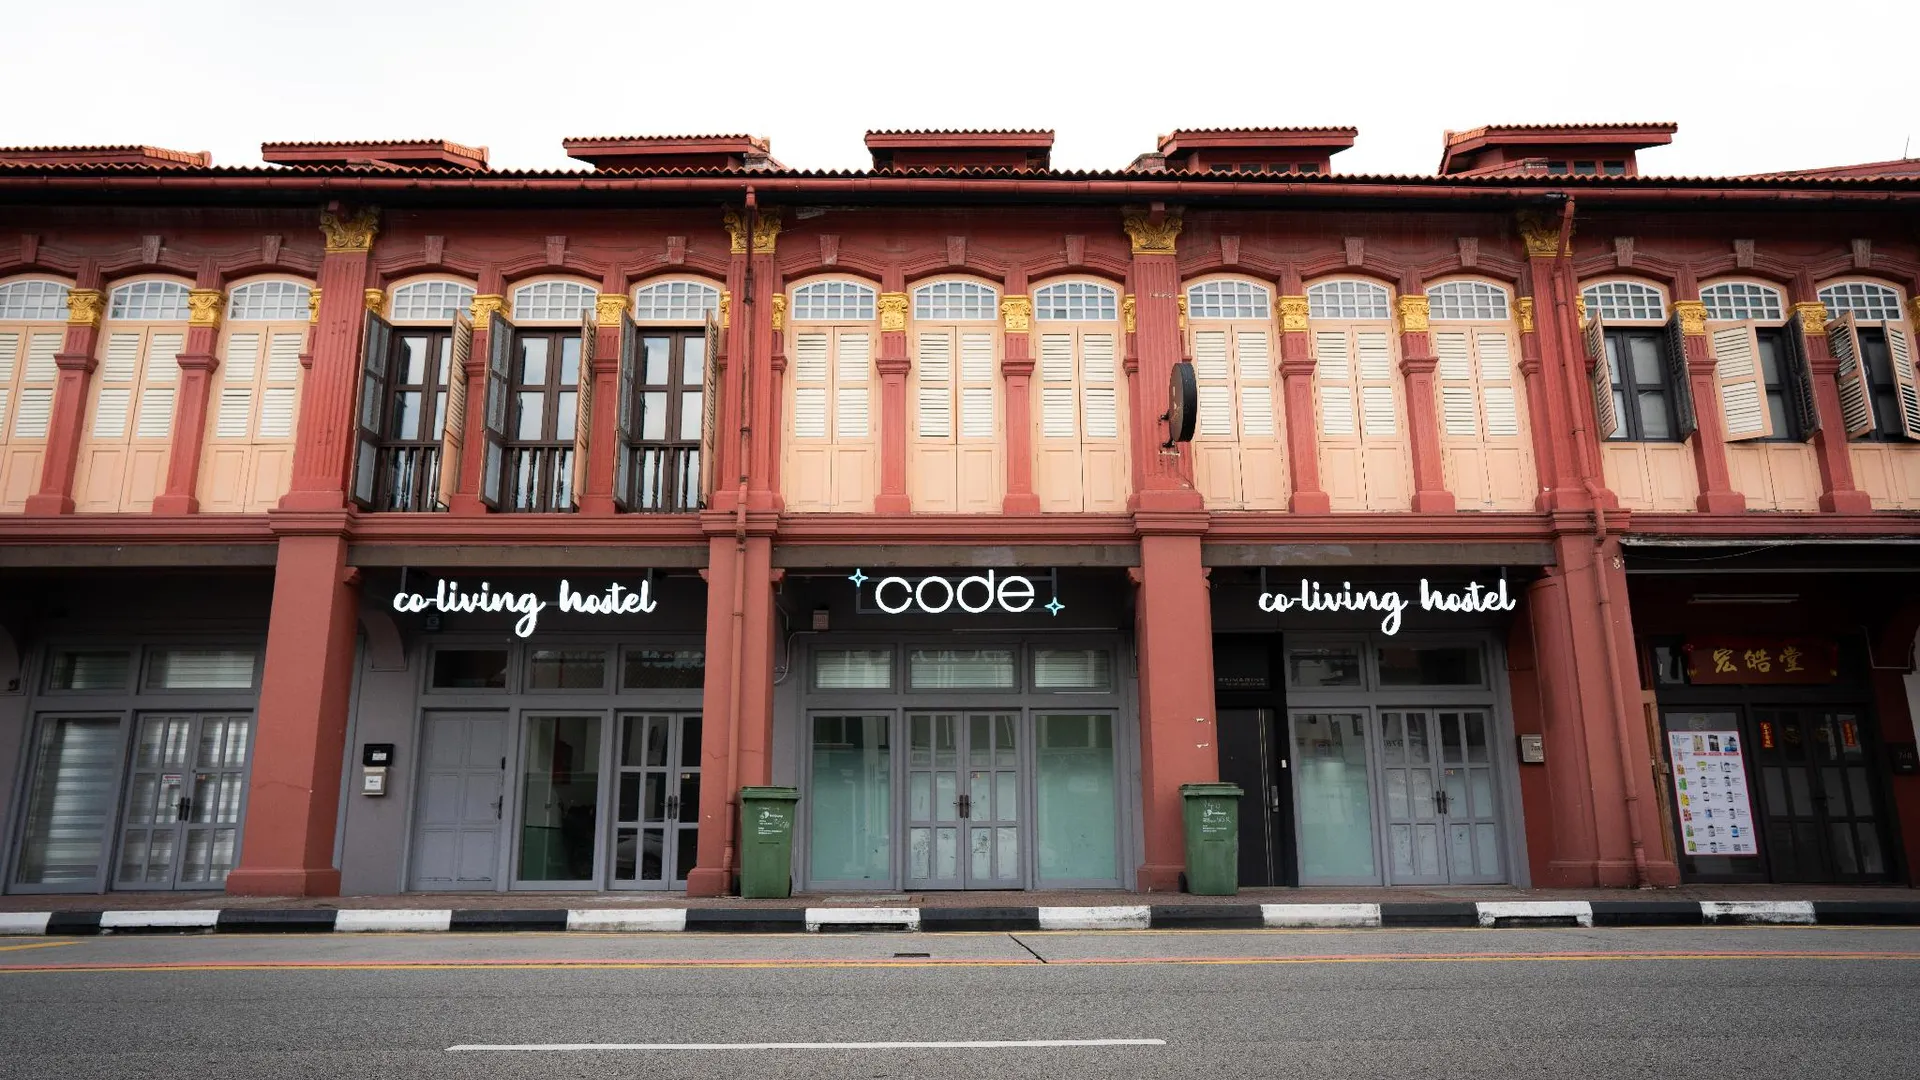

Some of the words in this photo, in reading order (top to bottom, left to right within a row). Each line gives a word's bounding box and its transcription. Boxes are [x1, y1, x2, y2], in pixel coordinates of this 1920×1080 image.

[393, 579, 546, 638] co-living
[560, 579, 657, 614] hostel
[875, 569, 1035, 614] code
[1258, 578, 1409, 636] co-living
[1420, 578, 1517, 612] hostel
